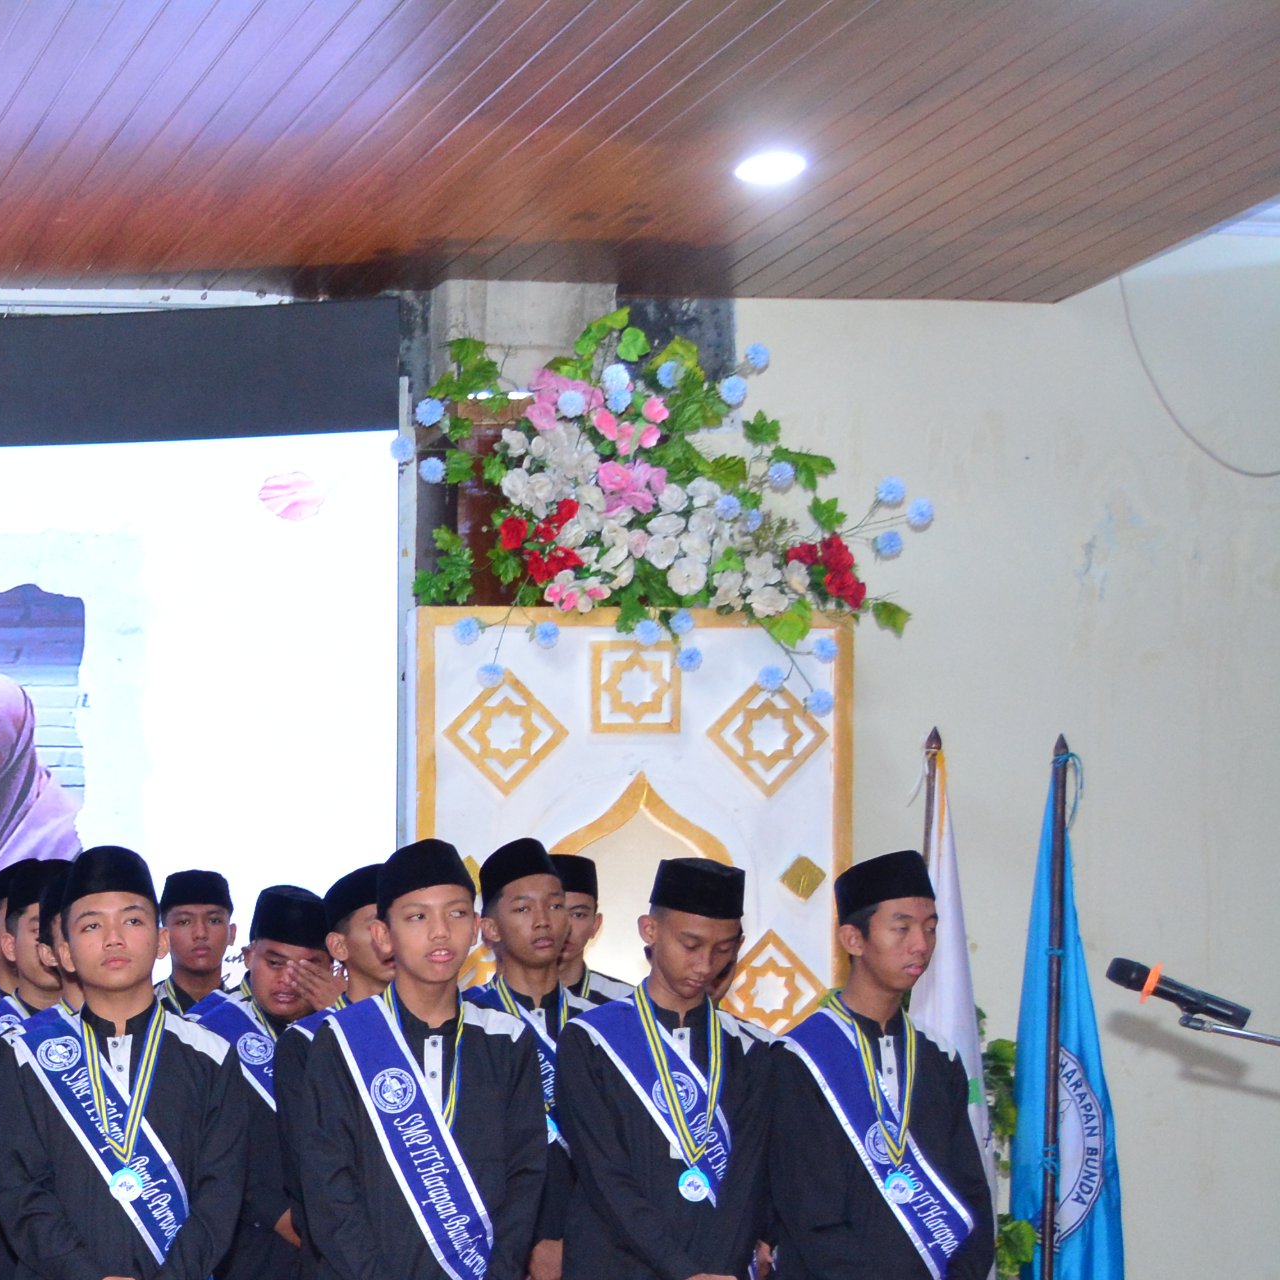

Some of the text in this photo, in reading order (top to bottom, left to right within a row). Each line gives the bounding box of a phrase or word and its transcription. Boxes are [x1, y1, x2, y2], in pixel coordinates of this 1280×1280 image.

[393, 1112, 433, 1150] SMP
[1059, 1060, 1100, 1206] HARAPAN BUNDA
[409, 1144, 441, 1171] IT
[704, 1142, 726, 1165] IT
[417, 1159, 456, 1220] Harapan
[911, 1190, 941, 1219] IT
